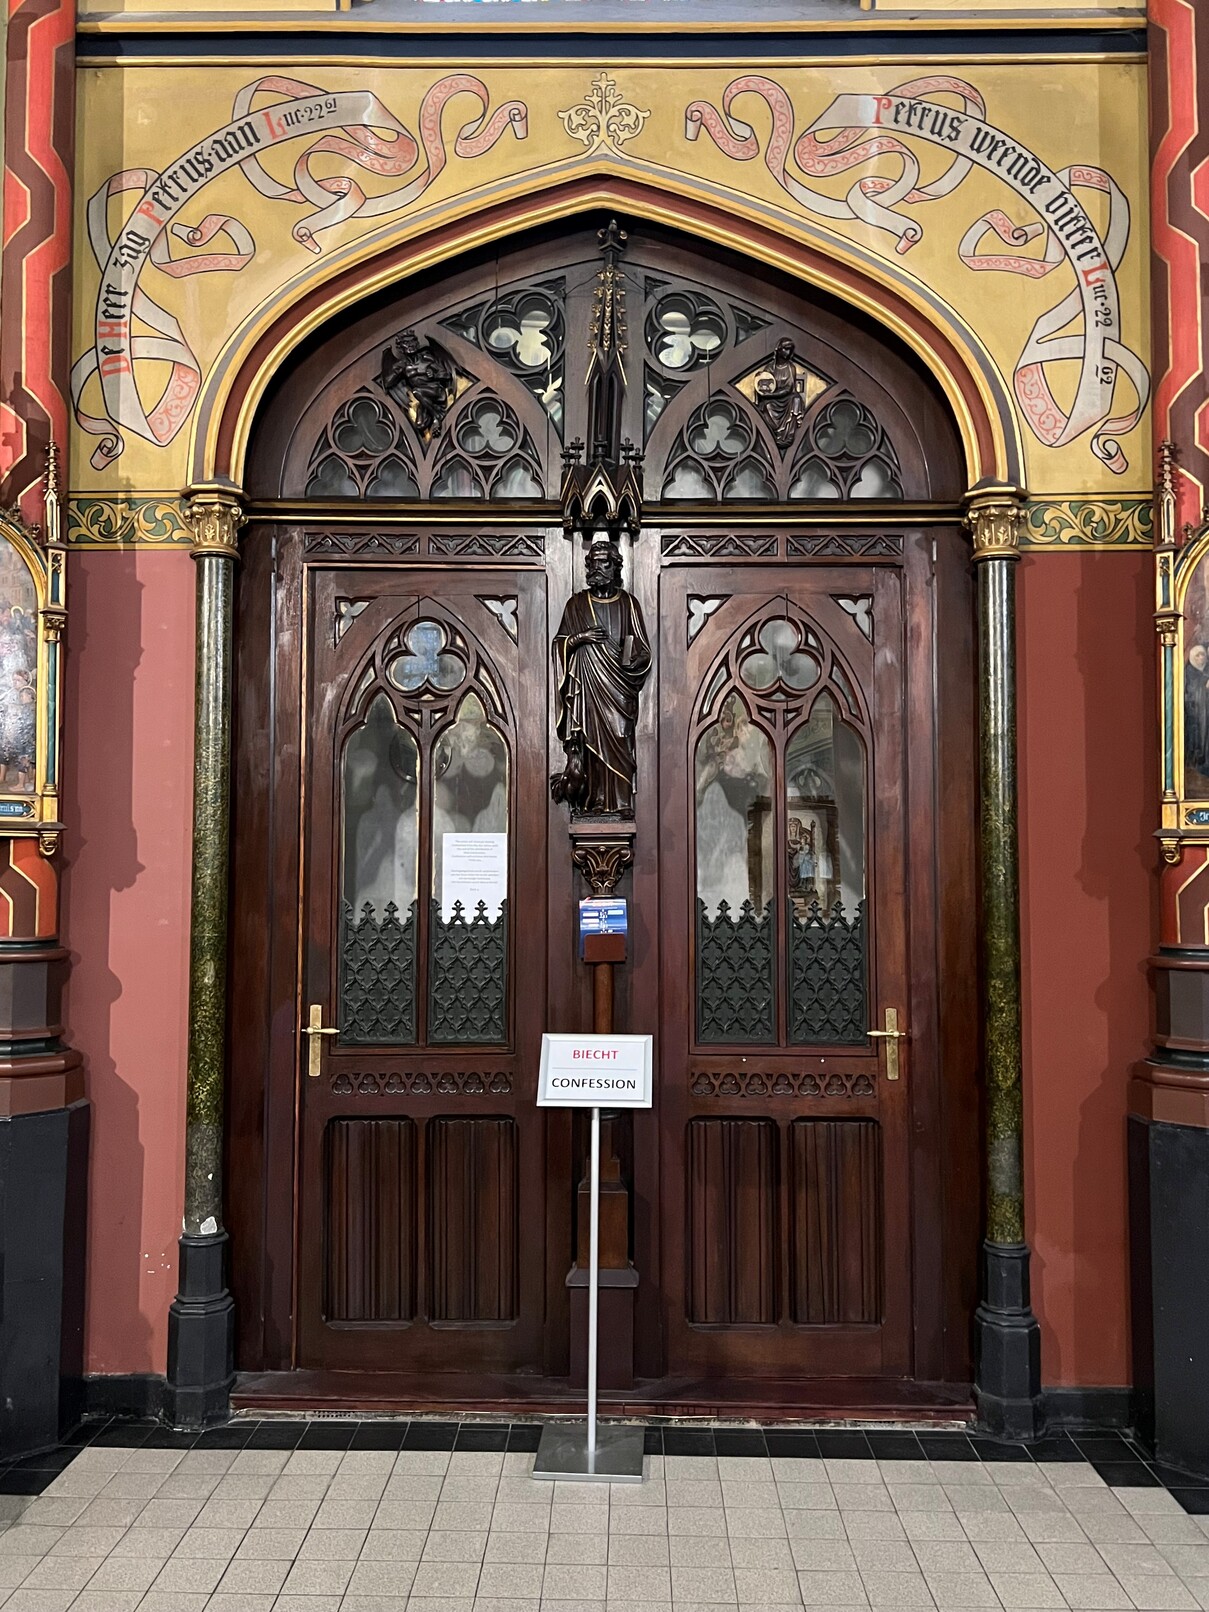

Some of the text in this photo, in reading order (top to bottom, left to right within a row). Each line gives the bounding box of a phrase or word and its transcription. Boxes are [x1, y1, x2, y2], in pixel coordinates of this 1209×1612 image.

[872, 97, 968, 142] Petrus
[969, 127, 1052, 194] weende
[1045, 190, 1101, 261] bitter
[98, 283, 129, 339] Heer
[100, 345, 131, 378] De
[572, 1049, 618, 1060] BIECHT
[551, 1077, 636, 1089] CONFESSION
